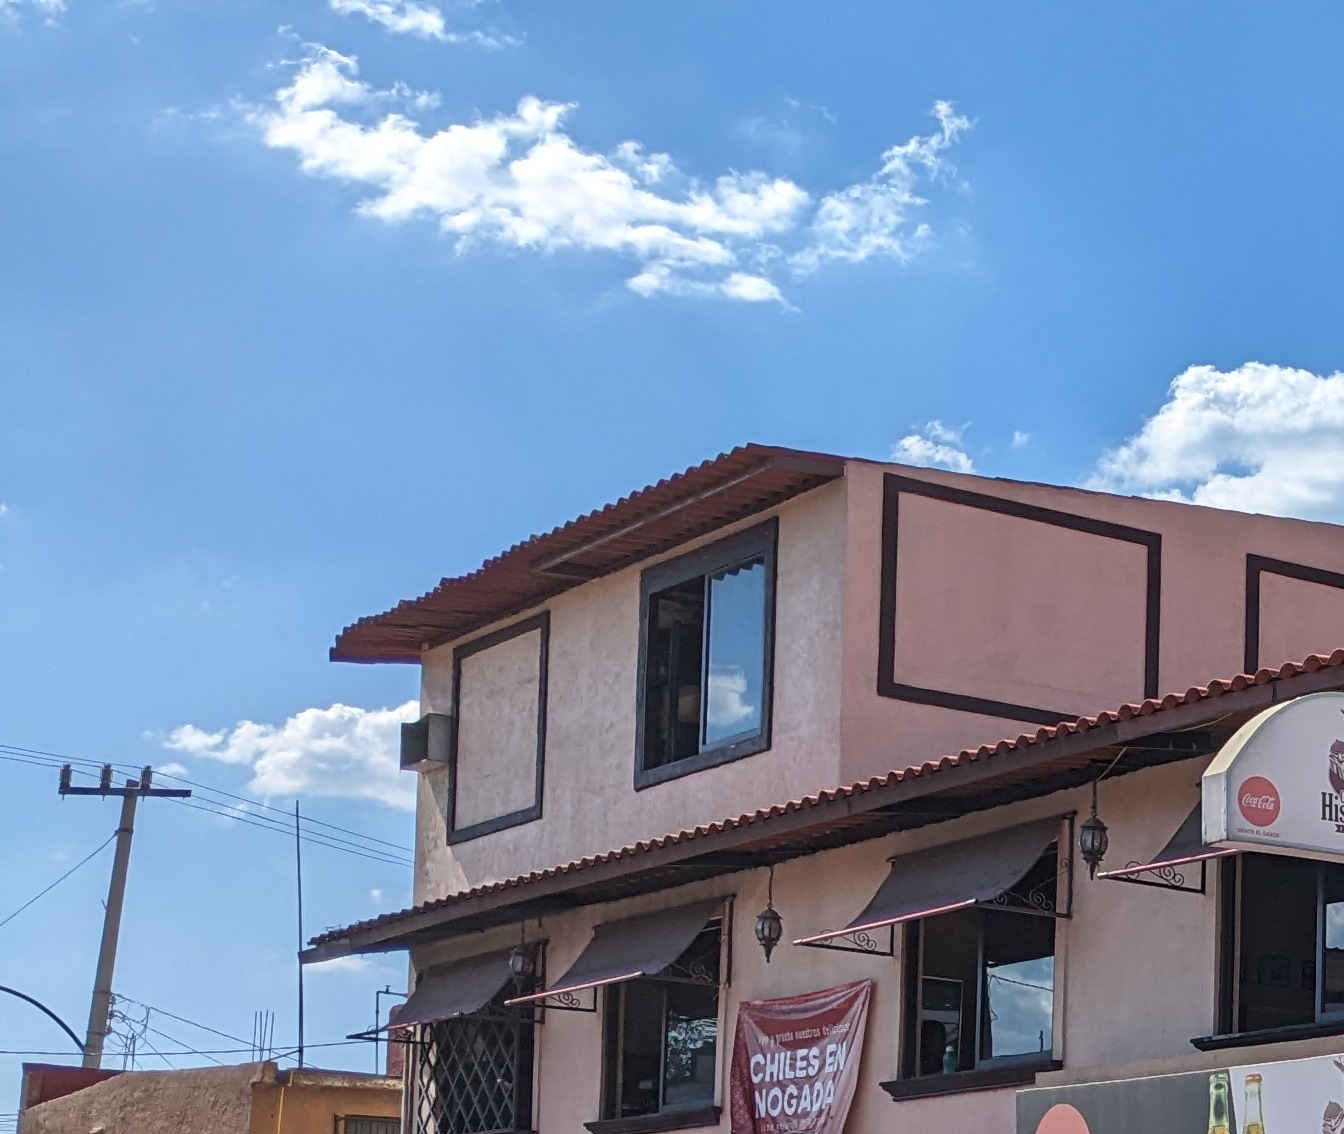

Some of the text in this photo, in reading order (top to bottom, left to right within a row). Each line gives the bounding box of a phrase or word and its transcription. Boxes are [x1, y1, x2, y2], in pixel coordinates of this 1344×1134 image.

[750, 1040, 847, 1084] CHILES EN
[755, 1080, 835, 1119] NOGADA
